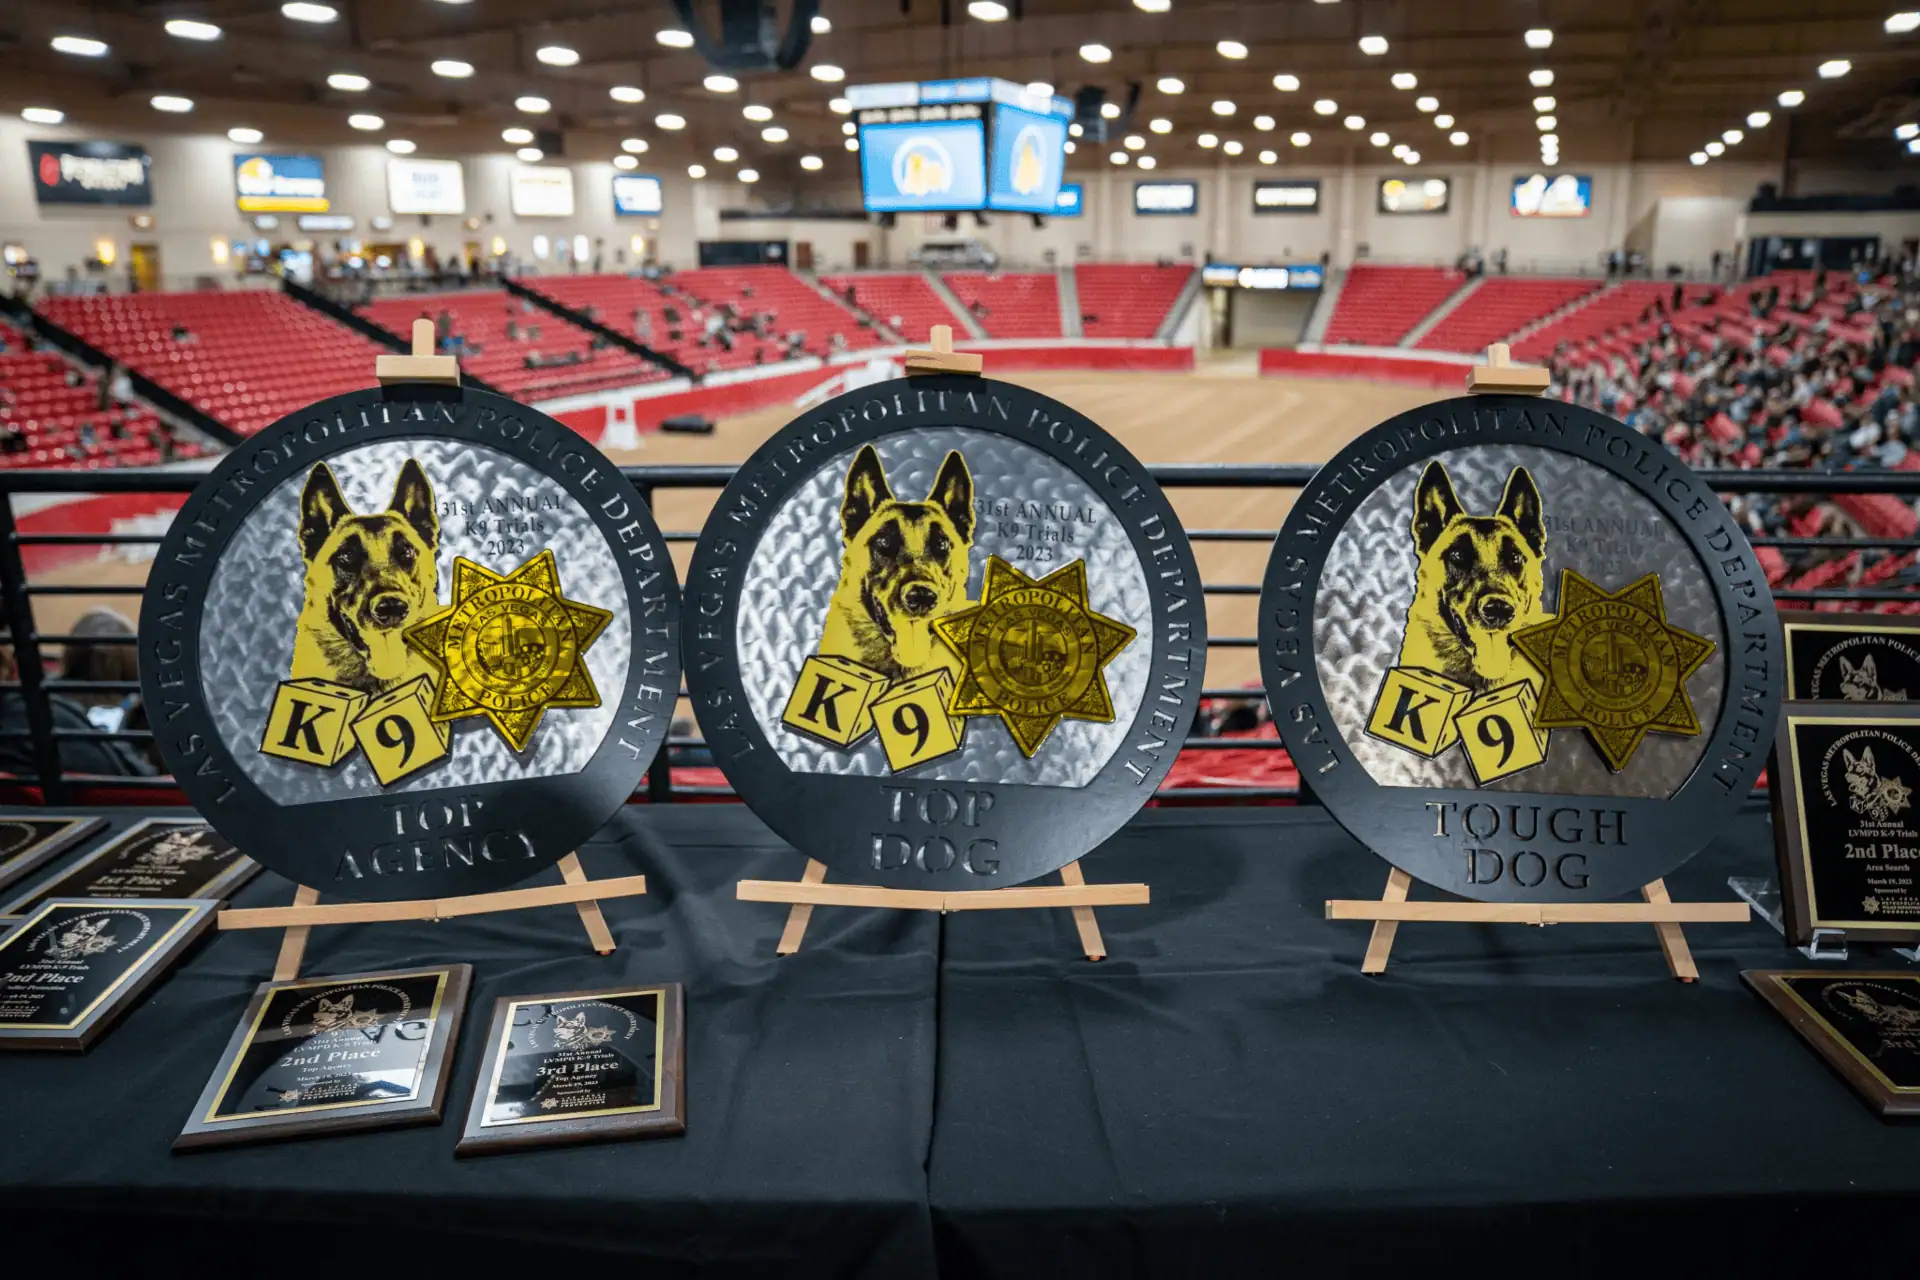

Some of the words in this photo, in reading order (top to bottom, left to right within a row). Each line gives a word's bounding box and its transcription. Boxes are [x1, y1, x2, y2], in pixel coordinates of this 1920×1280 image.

[476, 404, 605, 492] POLICE
[727, 390, 1014, 527] METROPOLITAN
[1026, 408, 1147, 508] POLICE
[173, 400, 457, 567] METROPOLITAN
[1296, 408, 1569, 544] METROPOLITAN
[1583, 423, 1709, 520] POLICE
[441, 501, 475, 517] 31st
[483, 495, 566, 514] ANNUAL
[465, 520, 488, 536] K9
[494, 517, 545, 534] Trials
[976, 500, 1009, 517] 31st
[1016, 503, 1097, 524] ANNUAL
[1578, 517, 1664, 536] ANNUAL
[487, 539, 525, 556] 2023
[997, 522, 1019, 538] K9
[1026, 524, 1075, 543] Trials
[1016, 545, 1053, 561] 2023
[448, 585, 574, 650] METROPOLITAN
[472, 608, 497, 633] LAS
[501, 603, 548, 628] VEGAS
[698, 537, 737, 672] VEGAS
[973, 589, 1094, 654] METROPOLITAN
[998, 611, 1023, 634] LAS
[1028, 607, 1071, 637] VEGAS
[1274, 555, 1309, 689] VEGAS
[601, 493, 669, 760] DEPARTMENT
[1553, 603, 1676, 668] METROPOLITAN
[1576, 621, 1600, 644] LAS
[1606, 621, 1650, 649] VEGAS
[153, 582, 191, 723] VEGAS
[1124, 512, 1192, 785] DEPARTMENT
[1703, 524, 1769, 797] DEPARTMENT
[479, 683, 554, 709] POLICE
[797, 673, 857, 733] K
[892, 702, 930, 757] 9
[1000, 691, 1069, 715] POLICE
[1581, 703, 1655, 727] POLICE
[277, 698, 337, 755] K
[375, 714, 416, 769] 9
[707, 686, 756, 759] LAS
[1289, 702, 1341, 776] LAS
[1383, 684, 1441, 744] K
[1477, 714, 1515, 769] 9
[1882, 732, 1913, 753] POLICE
[1824, 730, 1880, 760] METROPOLITAN
[176, 733, 238, 805] LAS
[1820, 761, 1830, 790] VEGAS
[381, 794, 485, 835] TOP
[879, 784, 996, 827] TOP
[1425, 801, 1629, 847] TOUGH
[1860, 820, 1875, 828] 31st
[1876, 820, 1904, 828] Annual
[332, 828, 537, 881] AGENCY
[869, 831, 1001, 877] DOG
[1844, 843, 1877, 859] 2nd
[1881, 844, 1920, 859] Plac
[1848, 829, 1879, 837] LVMPD
[1880, 829, 1895, 837] K-9
[1463, 848, 1594, 890] DOG
[36, 972, 85, 983] Place
[281, 1053, 320, 1067] 2nd
[327, 1049, 381, 1062] Place
[536, 1064, 567, 1076] 3rd
[572, 1062, 619, 1073] Place
